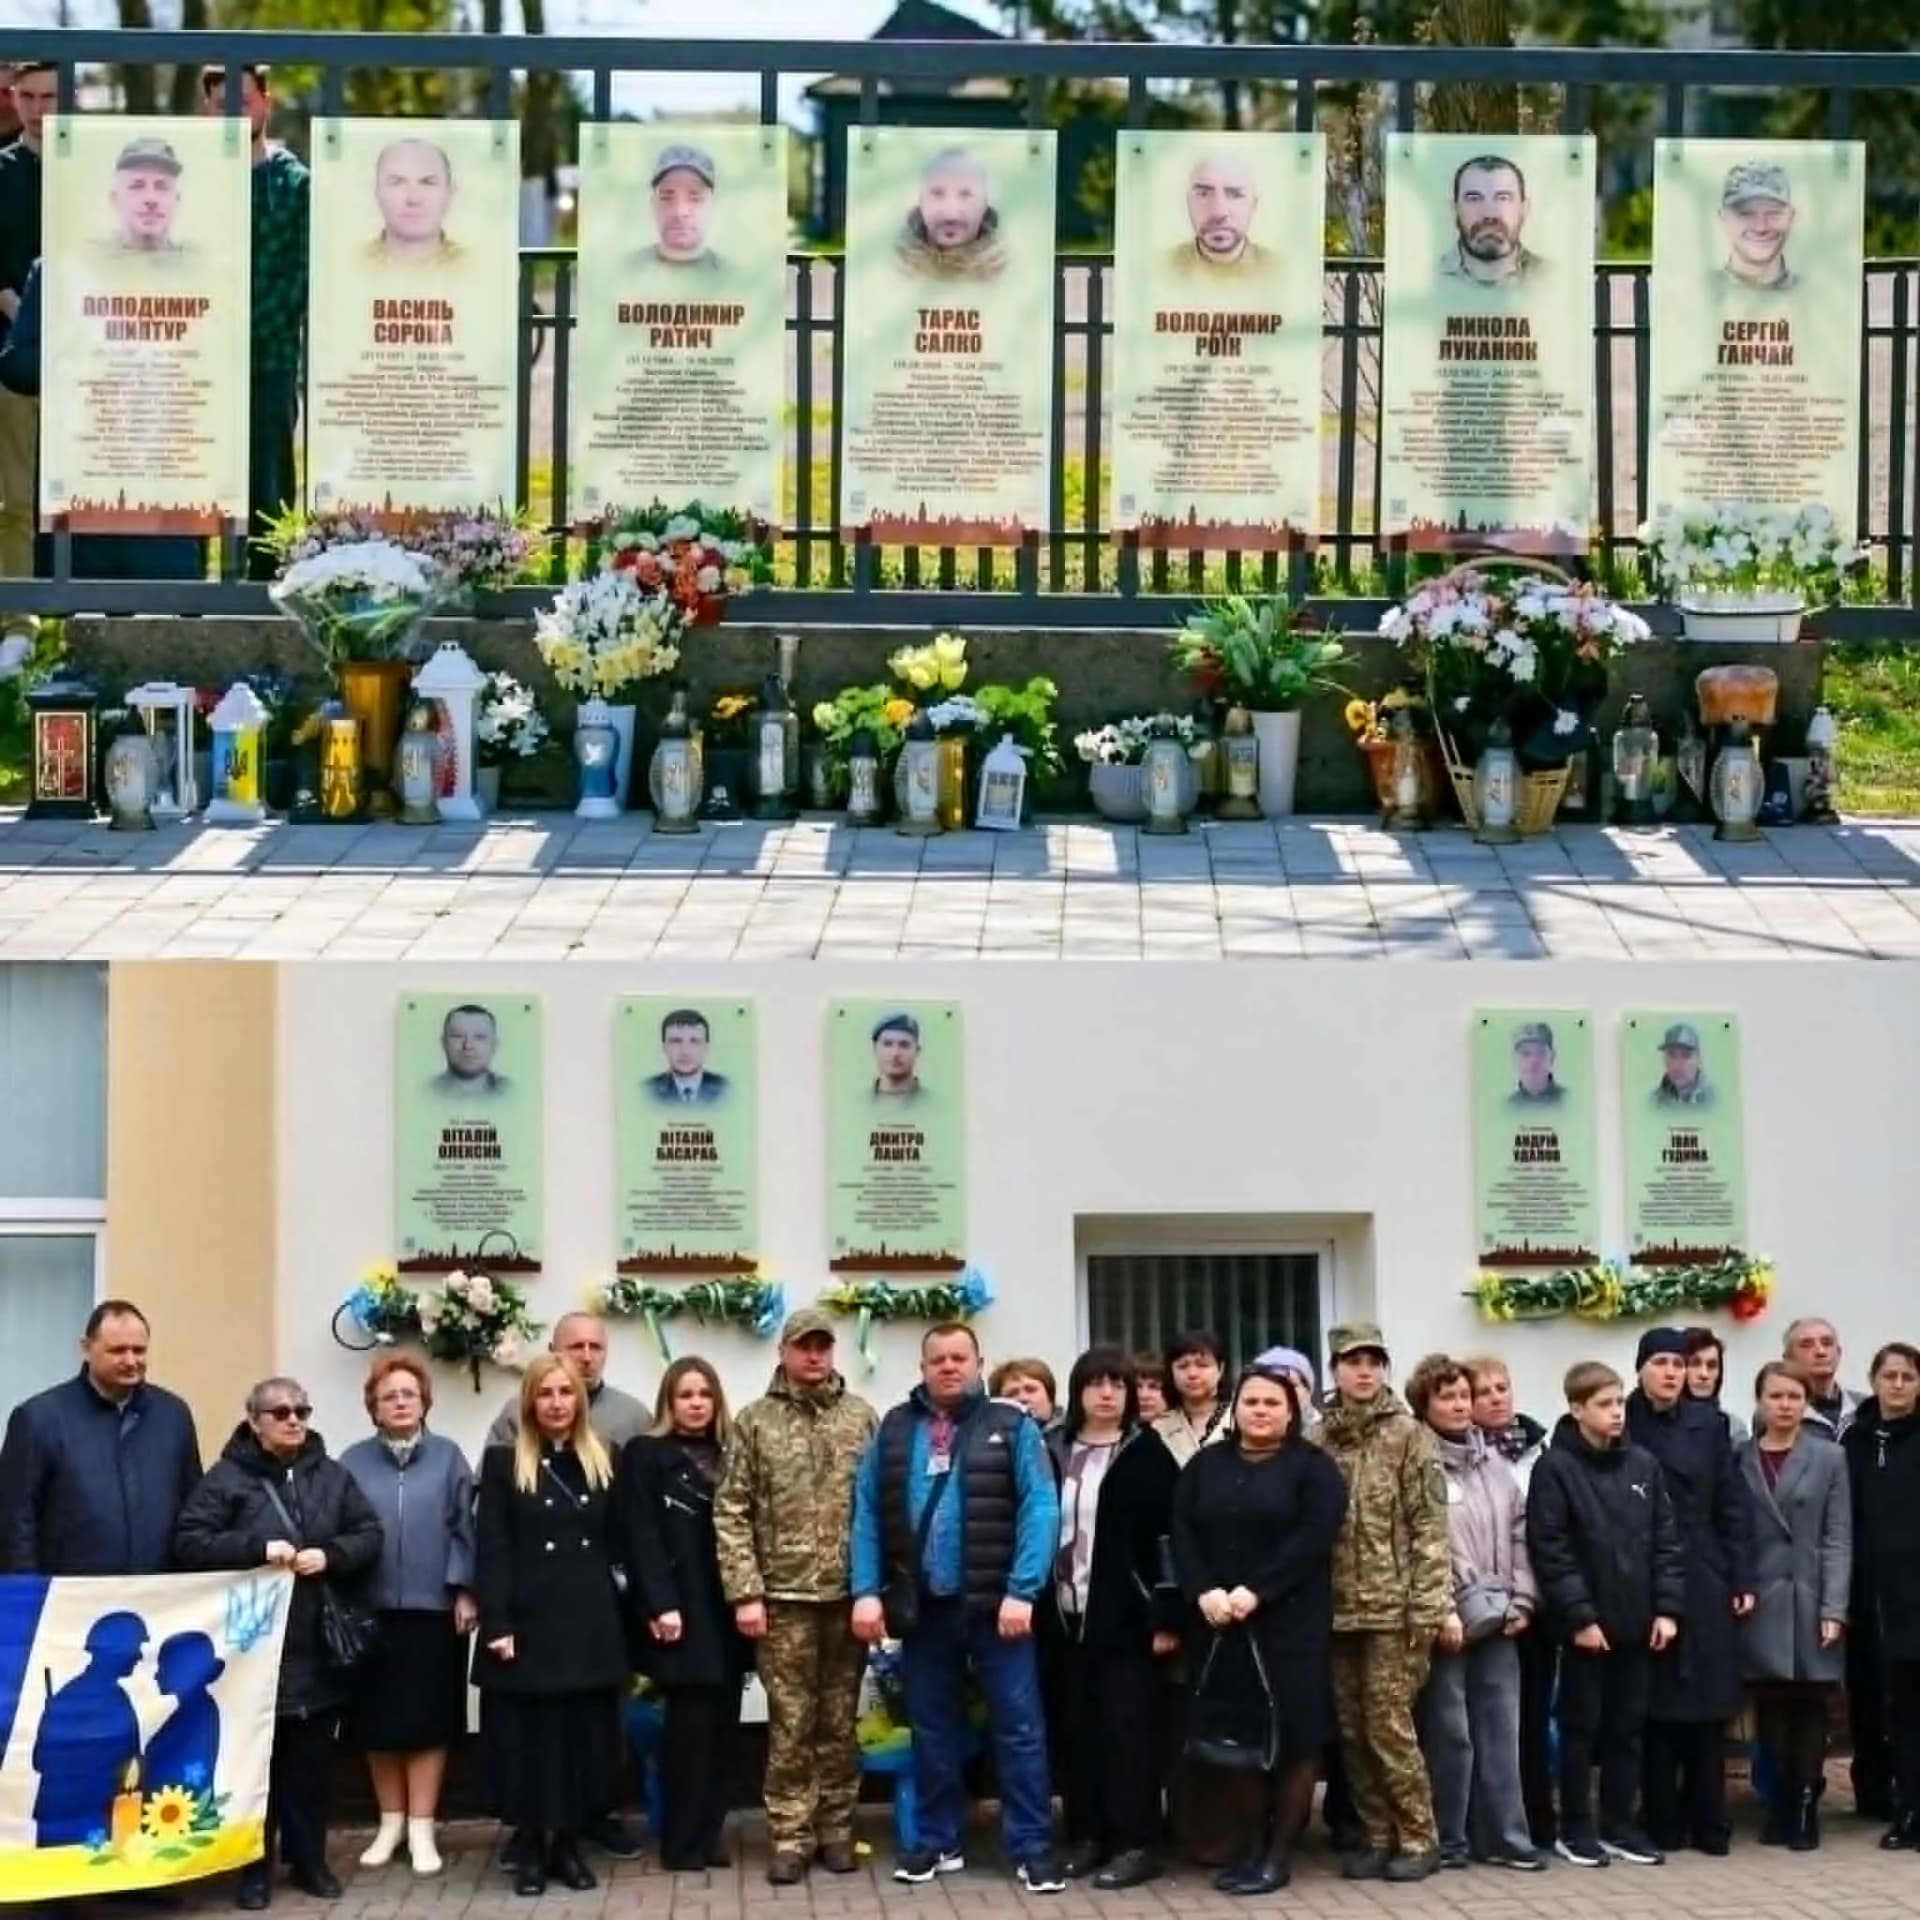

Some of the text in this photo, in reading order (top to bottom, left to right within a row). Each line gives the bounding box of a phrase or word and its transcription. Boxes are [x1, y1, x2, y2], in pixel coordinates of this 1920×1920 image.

[373, 299, 454, 320] ВАСИЛЬ
[618, 304, 745, 325] ВОЛОДИМИР
[917, 309, 980, 330] ТАРАС
[374, 322, 453, 344] СОРОКА
[1155, 312, 1283, 335] ВОЛОДИМИР
[1446, 317, 1531, 338] МИКОЛА
[1723, 319, 1790, 342] СЕРГІЙ
[650, 328, 712, 349] РАТИЧ
[915, 332, 982, 353] САЛКО
[442, 1126, 497, 1143] ВІТАЛІЙ
[660, 1130, 714, 1145] ВІТАЛІЙ
[869, 1132, 924, 1147] ДМИТРО
[1514, 1133, 1559, 1148] АНДРІЙ
[1671, 1135, 1698, 1148] ІВАН
[656, 1147, 718, 1161] БАСАРАБ
